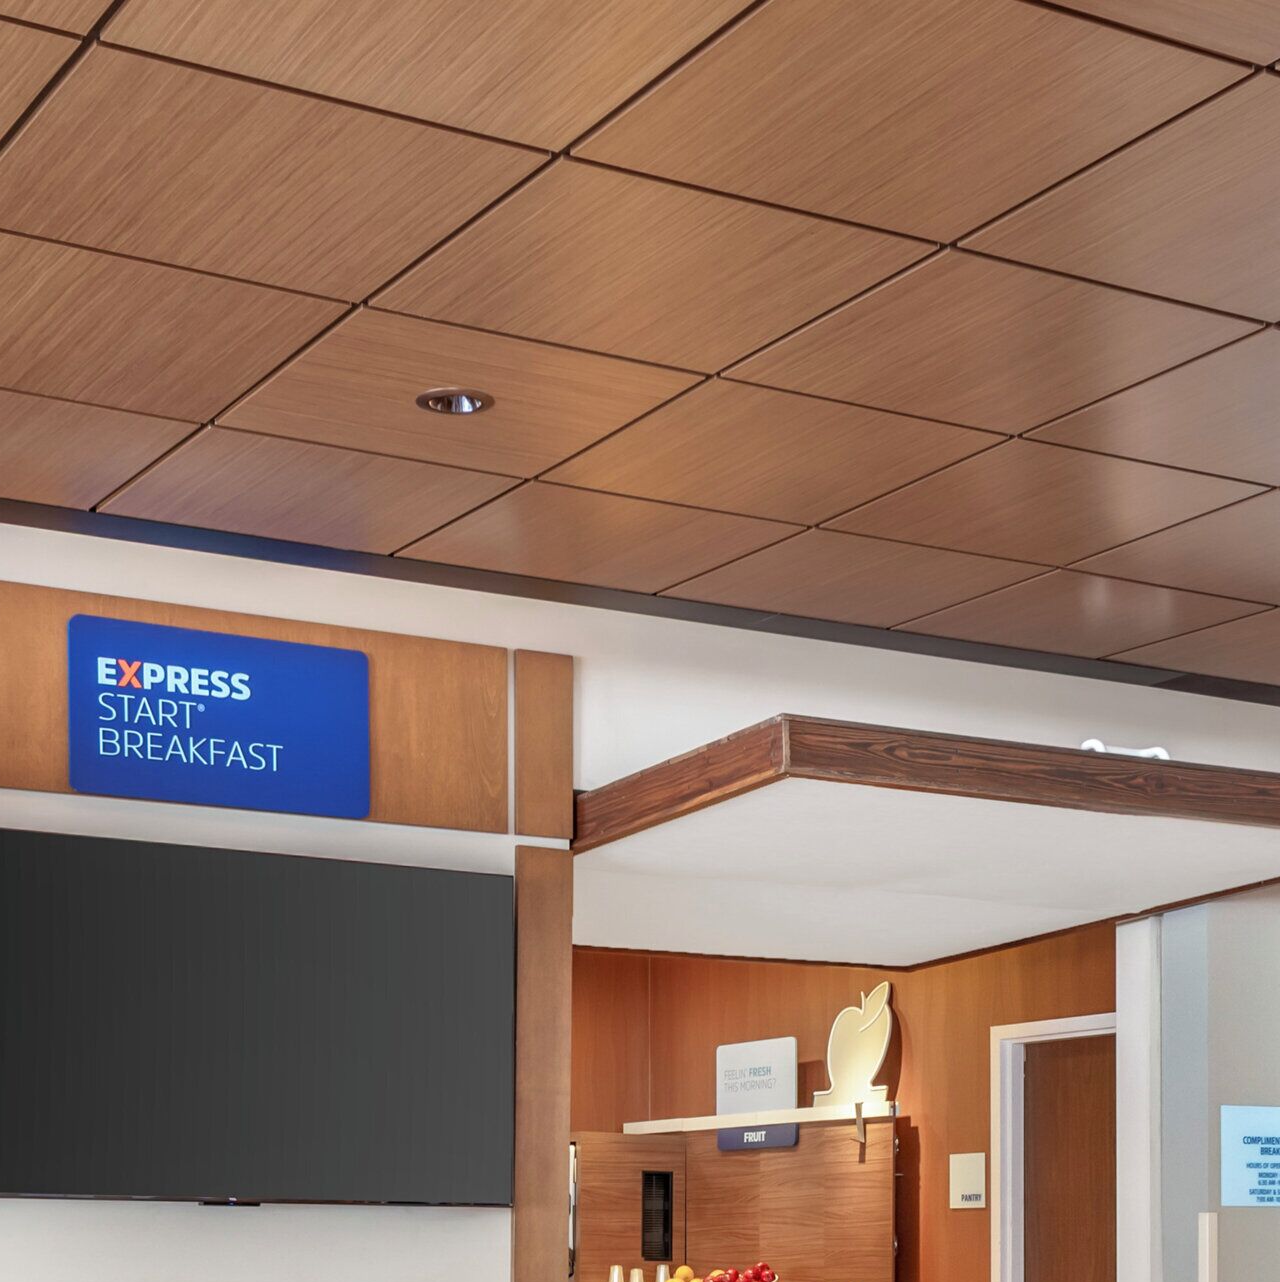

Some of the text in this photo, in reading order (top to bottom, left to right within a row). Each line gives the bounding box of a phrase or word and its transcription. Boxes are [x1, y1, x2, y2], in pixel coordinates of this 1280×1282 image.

[96, 656, 252, 701] EXPRESS
[98, 727, 284, 772] BREAKFAST
[749, 1066, 772, 1077] FRESH
[724, 1082, 739, 1094] THIS
[743, 1131, 767, 1143] FRUIT
[961, 1193, 982, 1202] PANTRY
